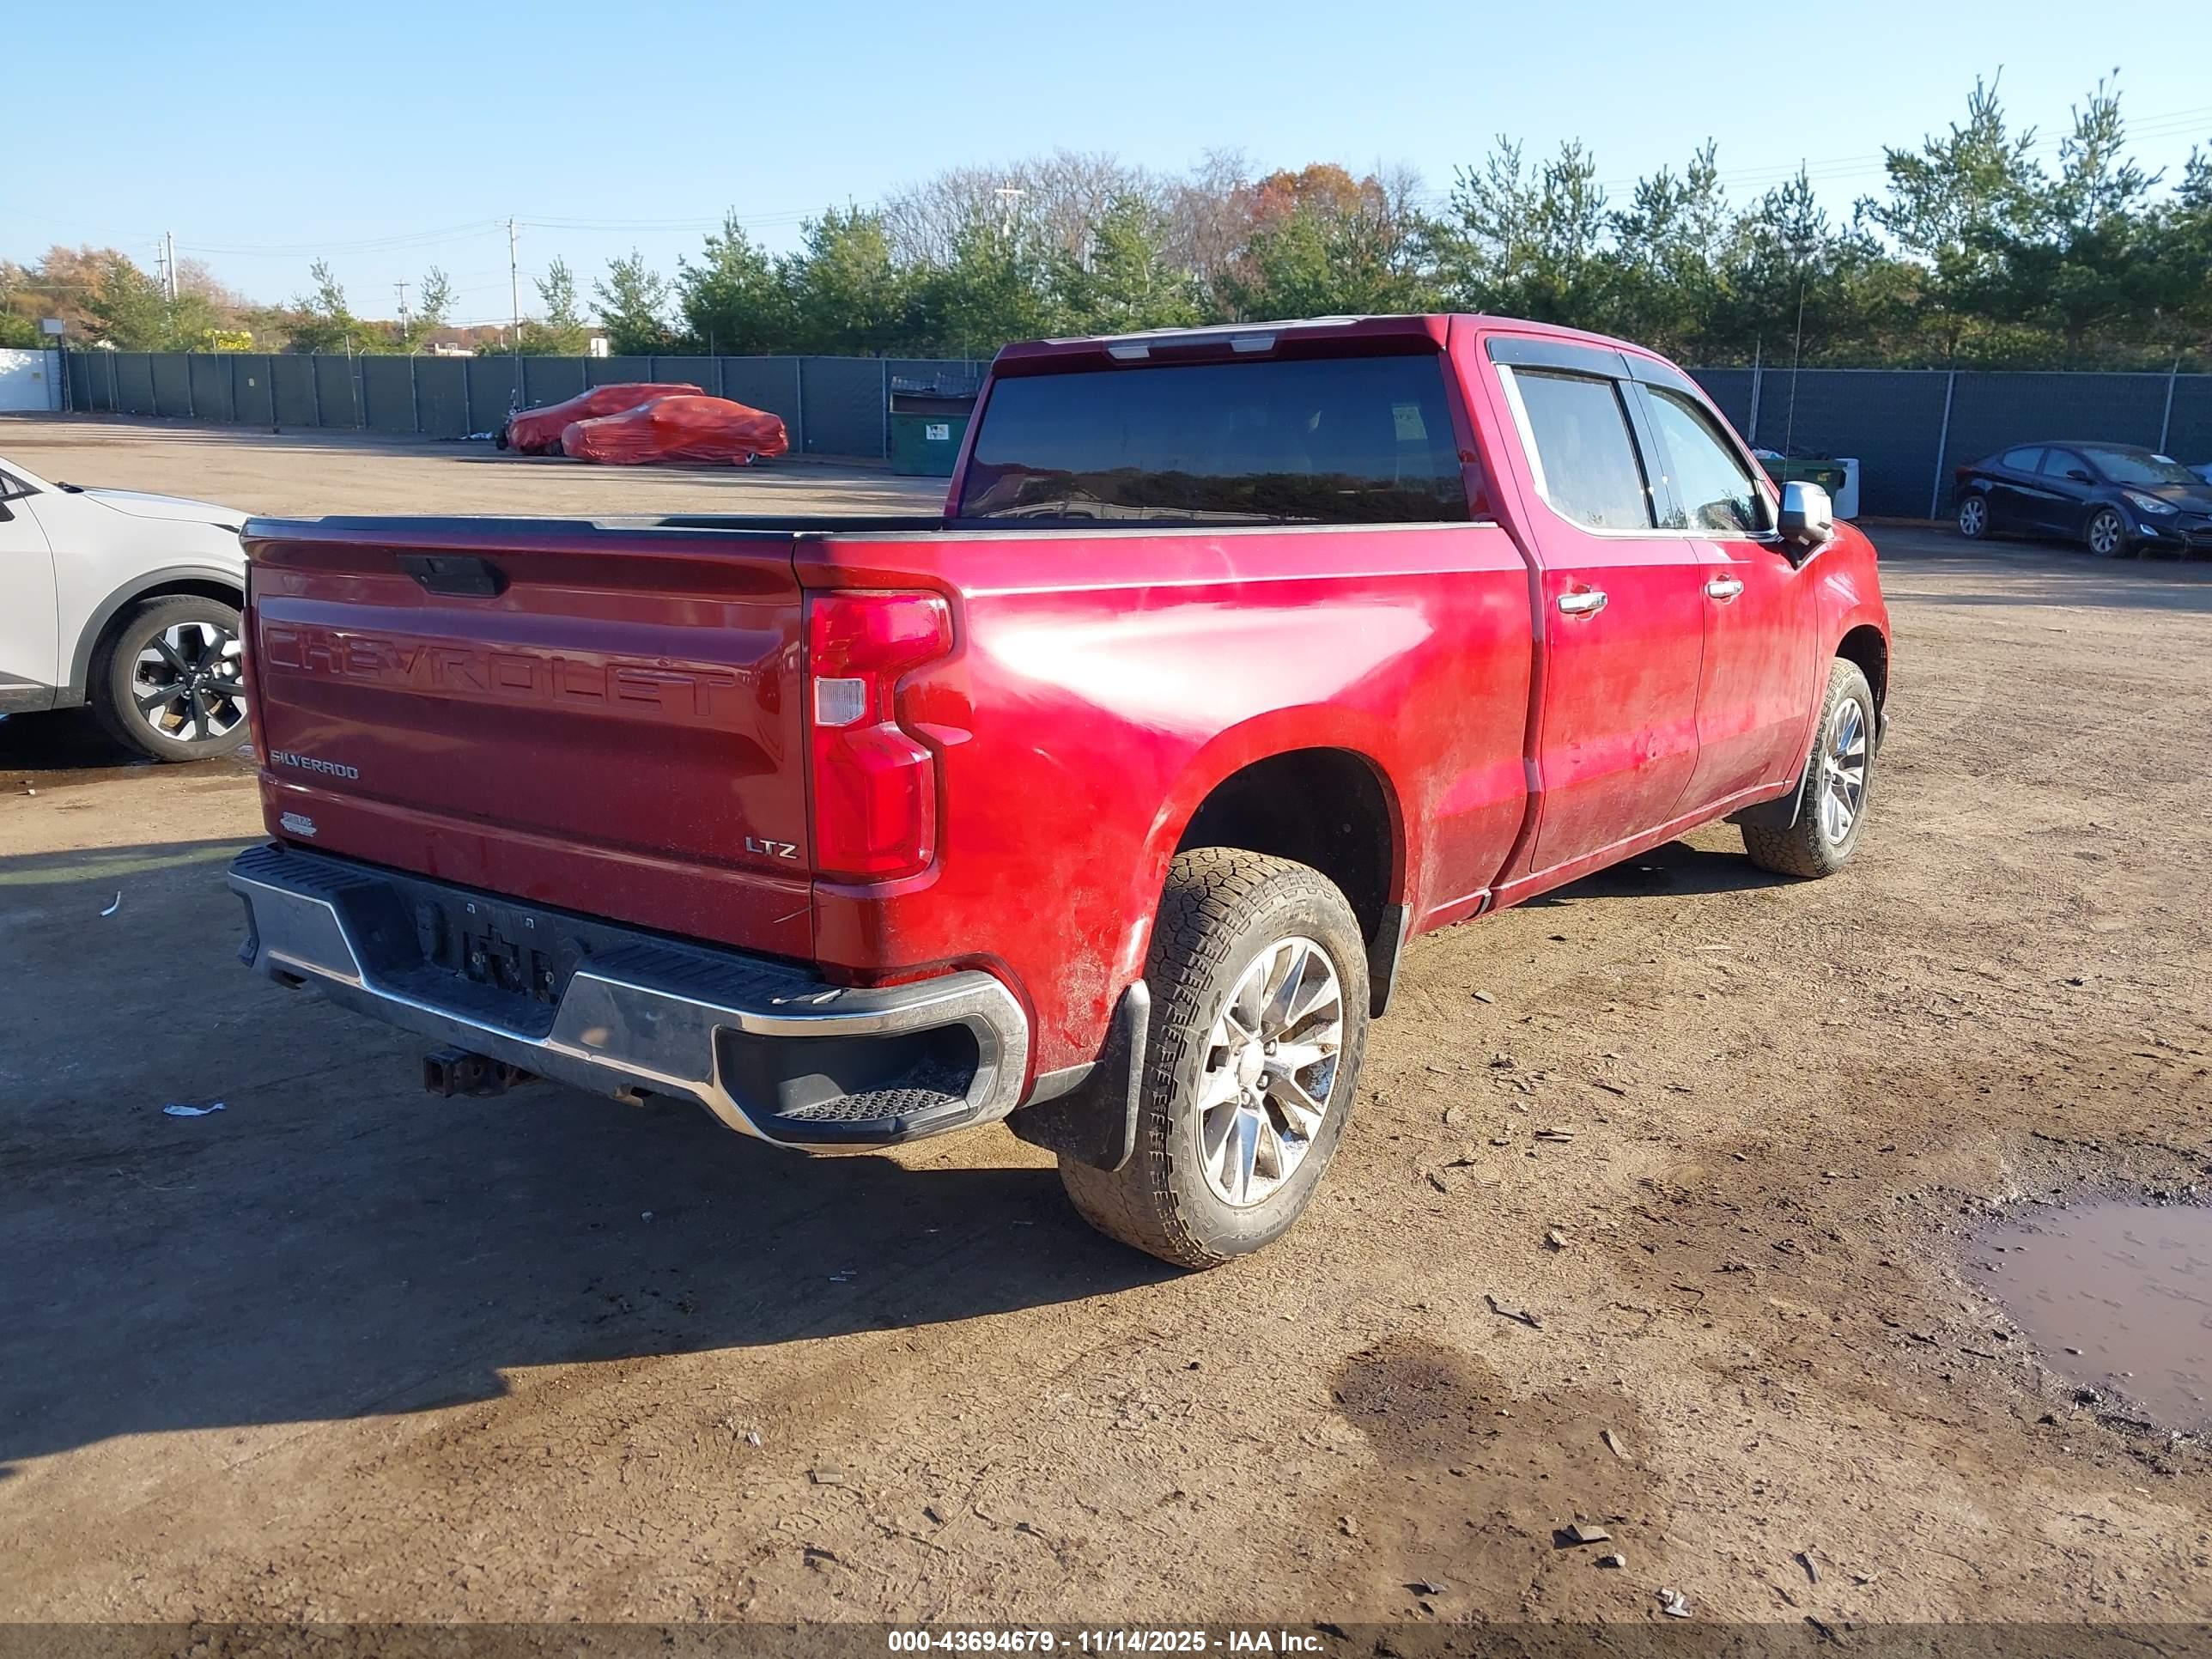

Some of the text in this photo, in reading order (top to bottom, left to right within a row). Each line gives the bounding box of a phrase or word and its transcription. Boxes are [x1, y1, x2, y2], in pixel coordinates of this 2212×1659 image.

[265, 626, 737, 716] CHEVROLET
[270, 750, 360, 780] SILVERADO
[745, 836, 798, 860] LTZ
